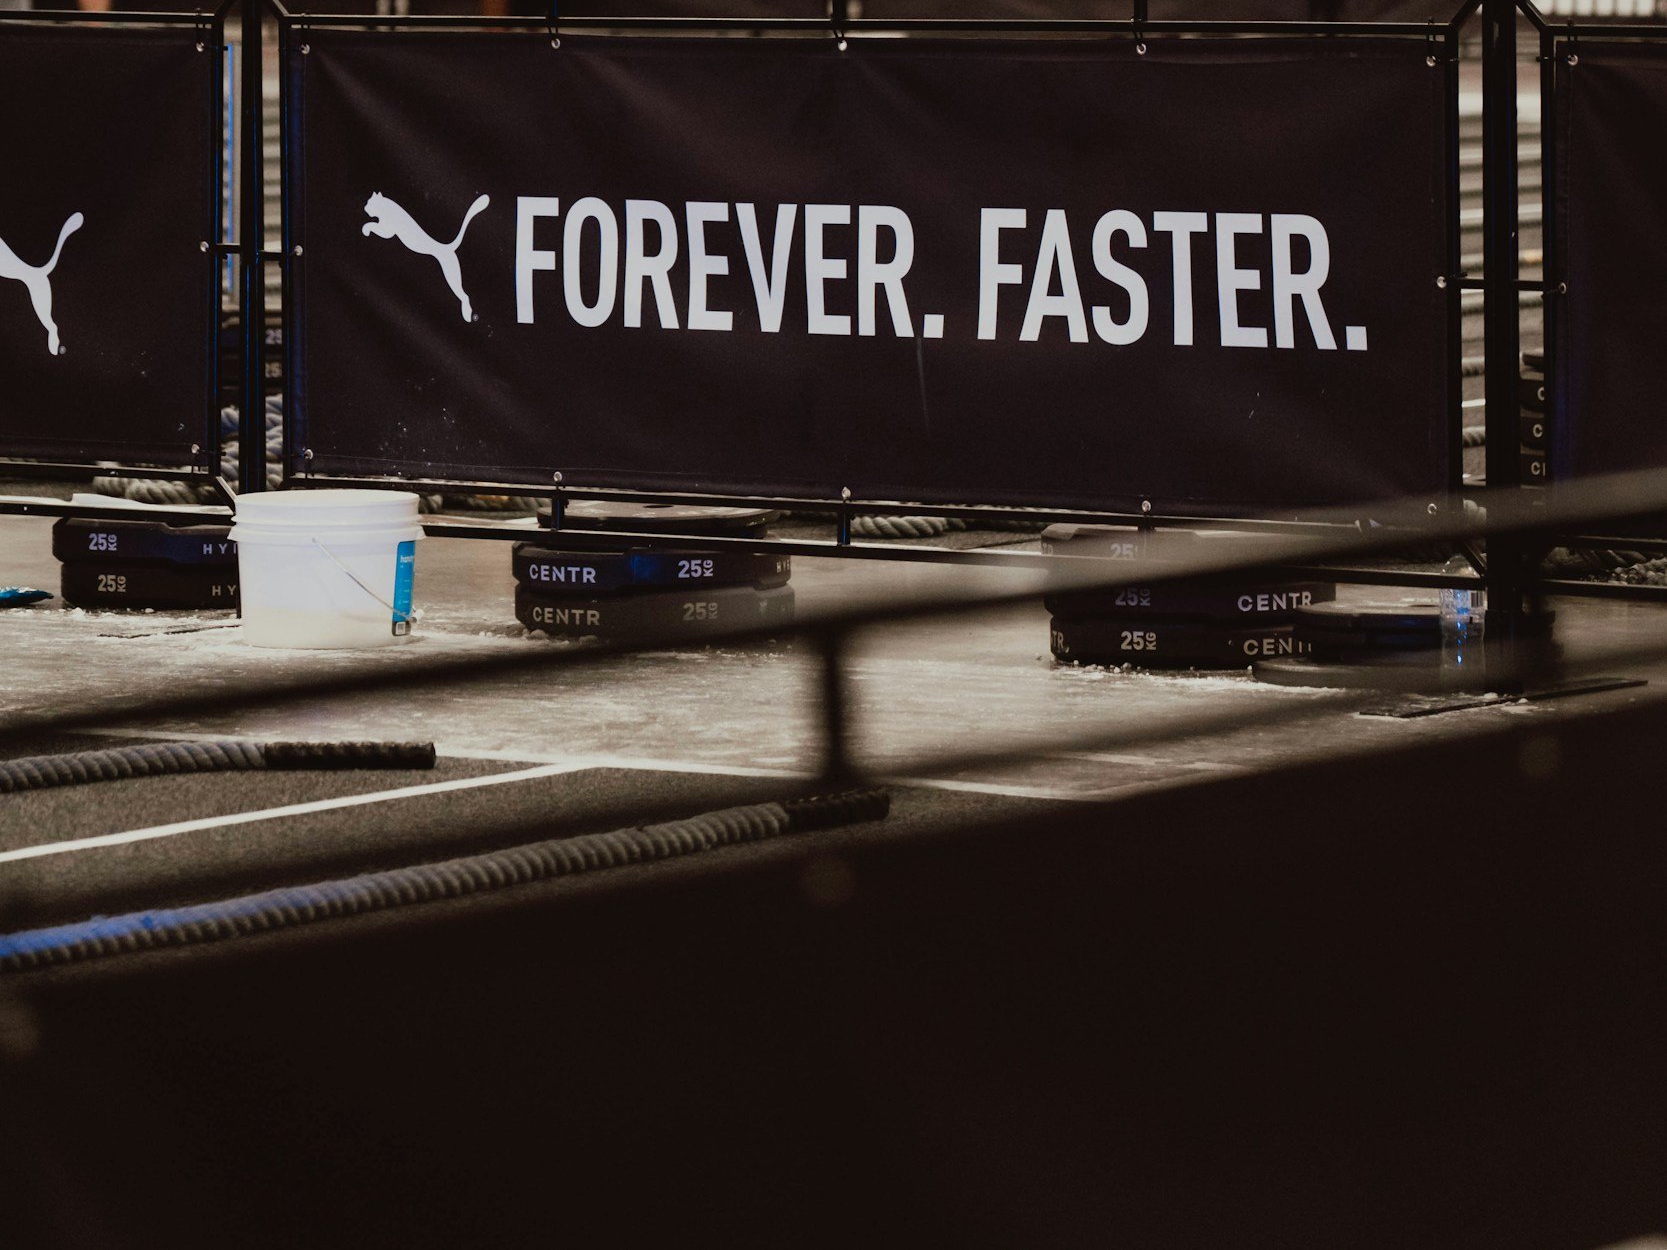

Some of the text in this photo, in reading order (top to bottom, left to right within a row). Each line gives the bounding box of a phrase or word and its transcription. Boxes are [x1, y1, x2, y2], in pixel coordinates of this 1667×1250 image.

[515, 196, 1368, 351] FOREVER. FASTER.
[529, 564, 596, 583] CENTR
[1238, 591, 1312, 612] CENTR
[532, 607, 600, 626] CENTR
[1243, 638, 1312, 656] CEN
